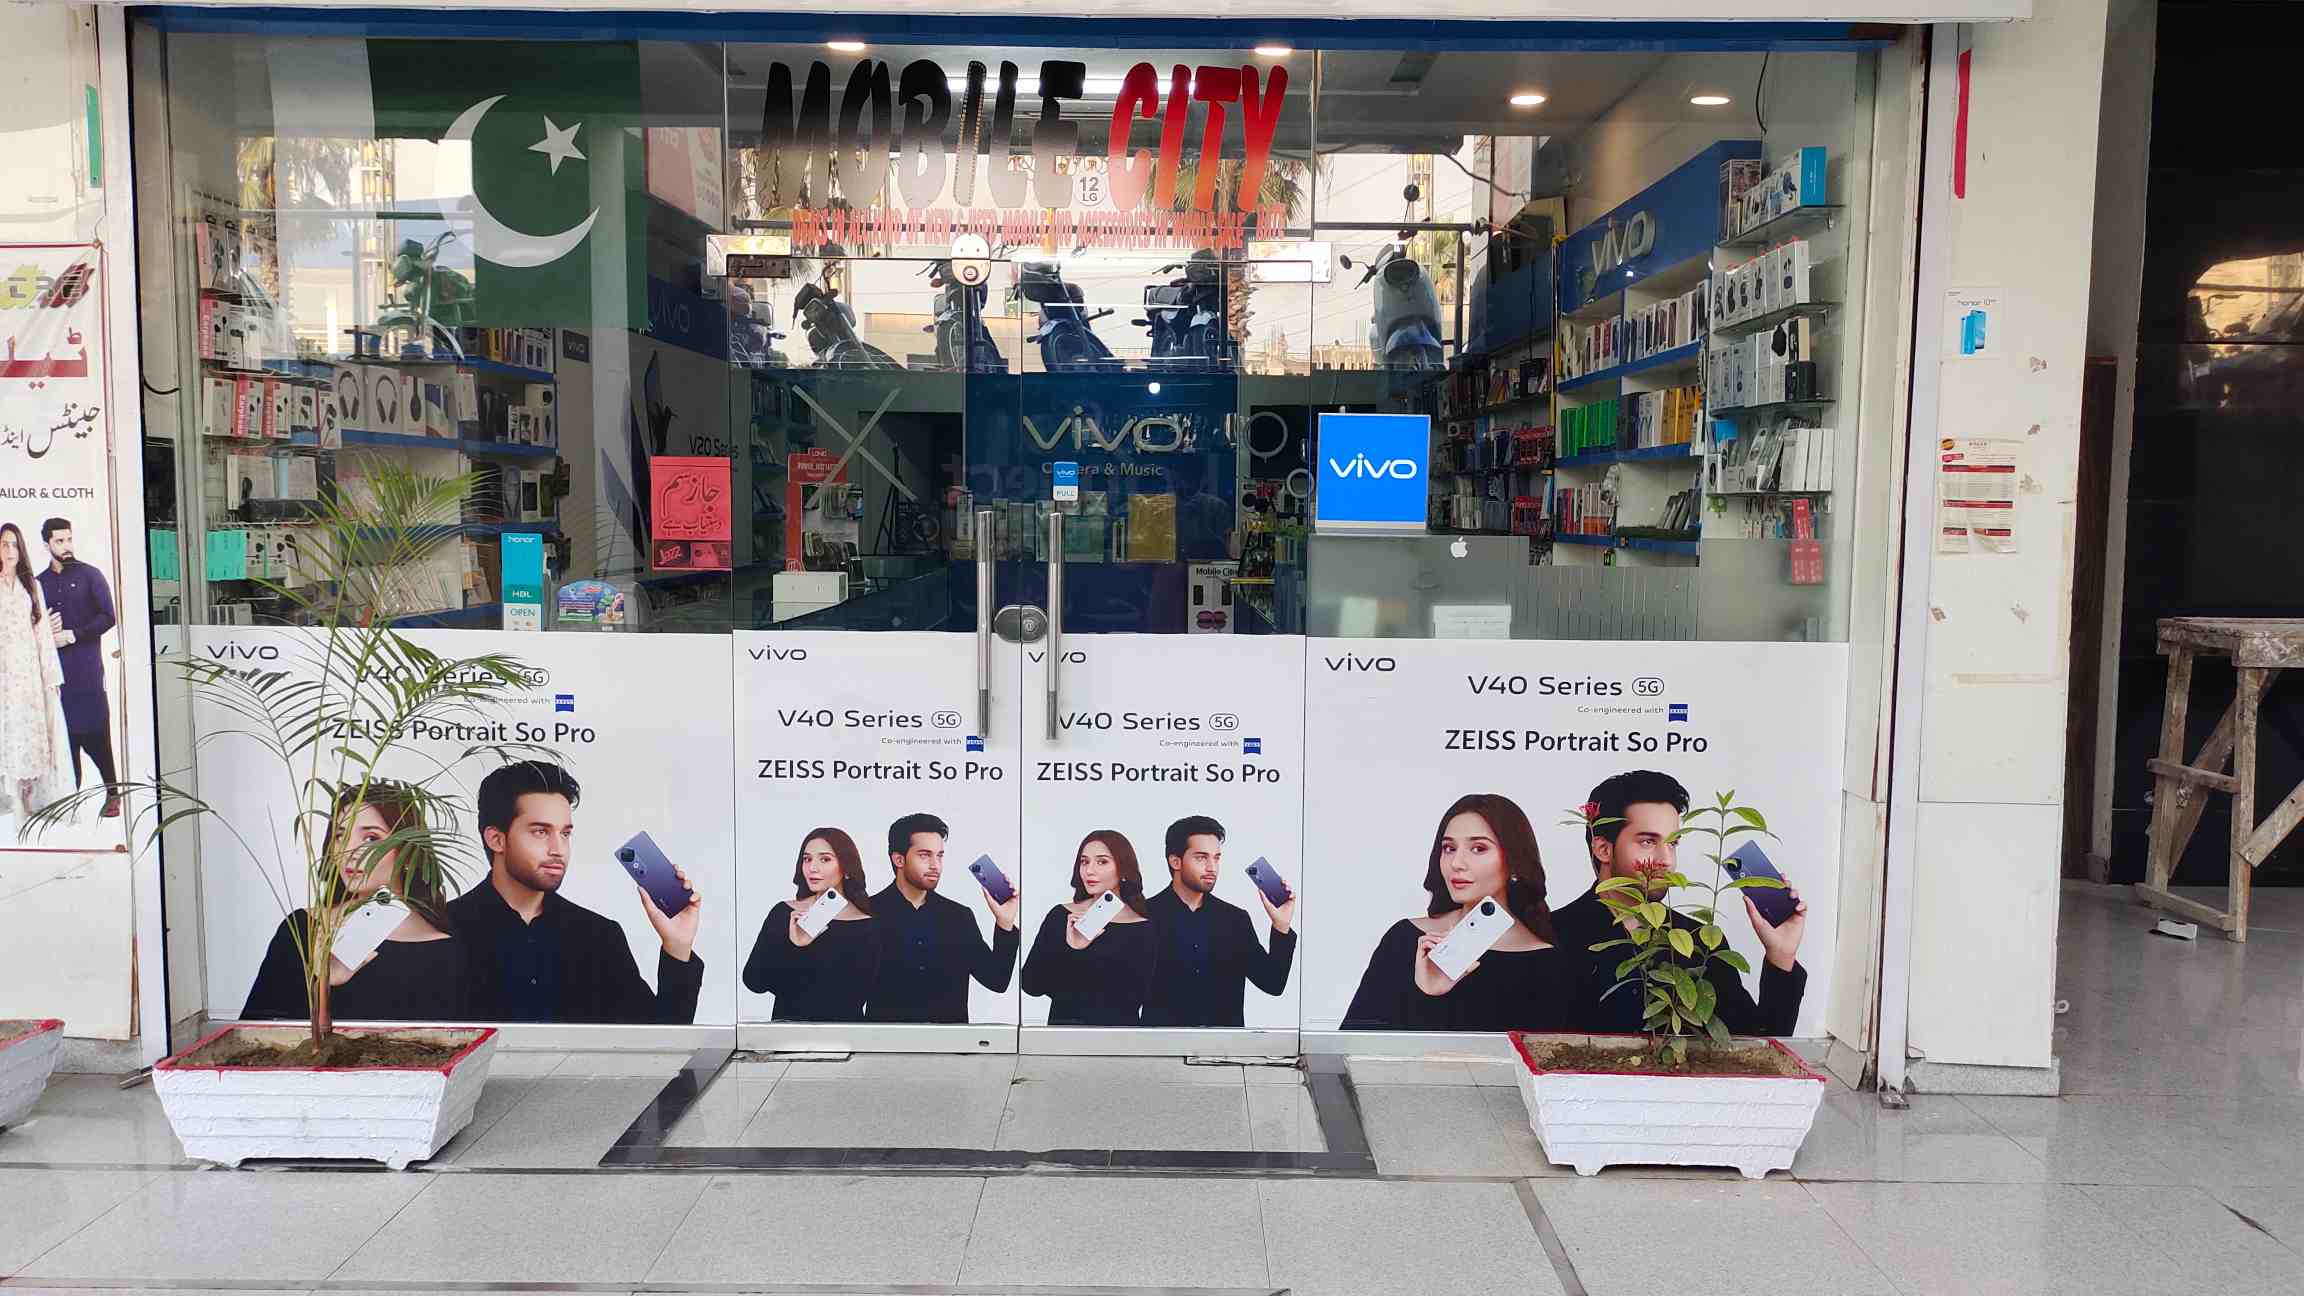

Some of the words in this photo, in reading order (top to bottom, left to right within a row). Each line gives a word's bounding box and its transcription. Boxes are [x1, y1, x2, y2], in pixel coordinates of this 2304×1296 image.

[758, 58, 1087, 209] MOBILE
[1108, 62, 1288, 212] CITY
[1079, 176, 1099, 192] 12
[1082, 192, 1098, 202] LG
[1592, 210, 1656, 274] vivo
[1023, 405, 1183, 451] vivo
[1041, 462, 1099, 476] Cera
[1103, 462, 1115, 476] &
[1120, 463, 1163, 477] Music
[1056, 468, 1076, 478] vivo
[1329, 452, 1418, 480] vivo
[39, 487, 49, 499] &
[52, 487, 94, 499] CLOTH
[1056, 489, 1076, 498] PULL
[510, 607, 536, 618] OPEN
[207, 640, 279, 660] vivo
[748, 644, 807, 661] vivo
[1325, 652, 1396, 672] vivo
[1468, 675, 1528, 695] V40
[1539, 676, 1623, 696] Series
[1637, 679, 1661, 694] 5G
[778, 709, 834, 728] V40
[844, 710, 923, 728] Series
[935, 713, 958, 727] 5G
[1577, 706, 1642, 716] Co-engineered
[1644, 705, 1664, 714] with
[333, 719, 402, 740] ZEISS
[413, 721, 508, 742] Portrait
[515, 722, 546, 743] So
[554, 722, 596, 743] Pro
[1122, 712, 1201, 731] Series
[1213, 716, 1236, 729] 5G
[880, 737, 942, 747] Co-engineered
[1159, 739, 1219, 749] Co-engineered
[1220, 739, 1239, 748] with
[1444, 729, 1516, 751] ZEISS
[1525, 730, 1620, 752] Portrait
[1627, 731, 1658, 753] So
[1666, 732, 1708, 753] Pro
[758, 759, 825, 779] ZEISS
[833, 760, 922, 780] Portrait
[928, 761, 957, 780] So
[965, 761, 1003, 781] Pro
[1036, 762, 1103, 782] ZEISS
[1111, 762, 1199, 782] Portrait
[1206, 763, 1234, 783] So
[1242, 764, 1280, 783] Pro
